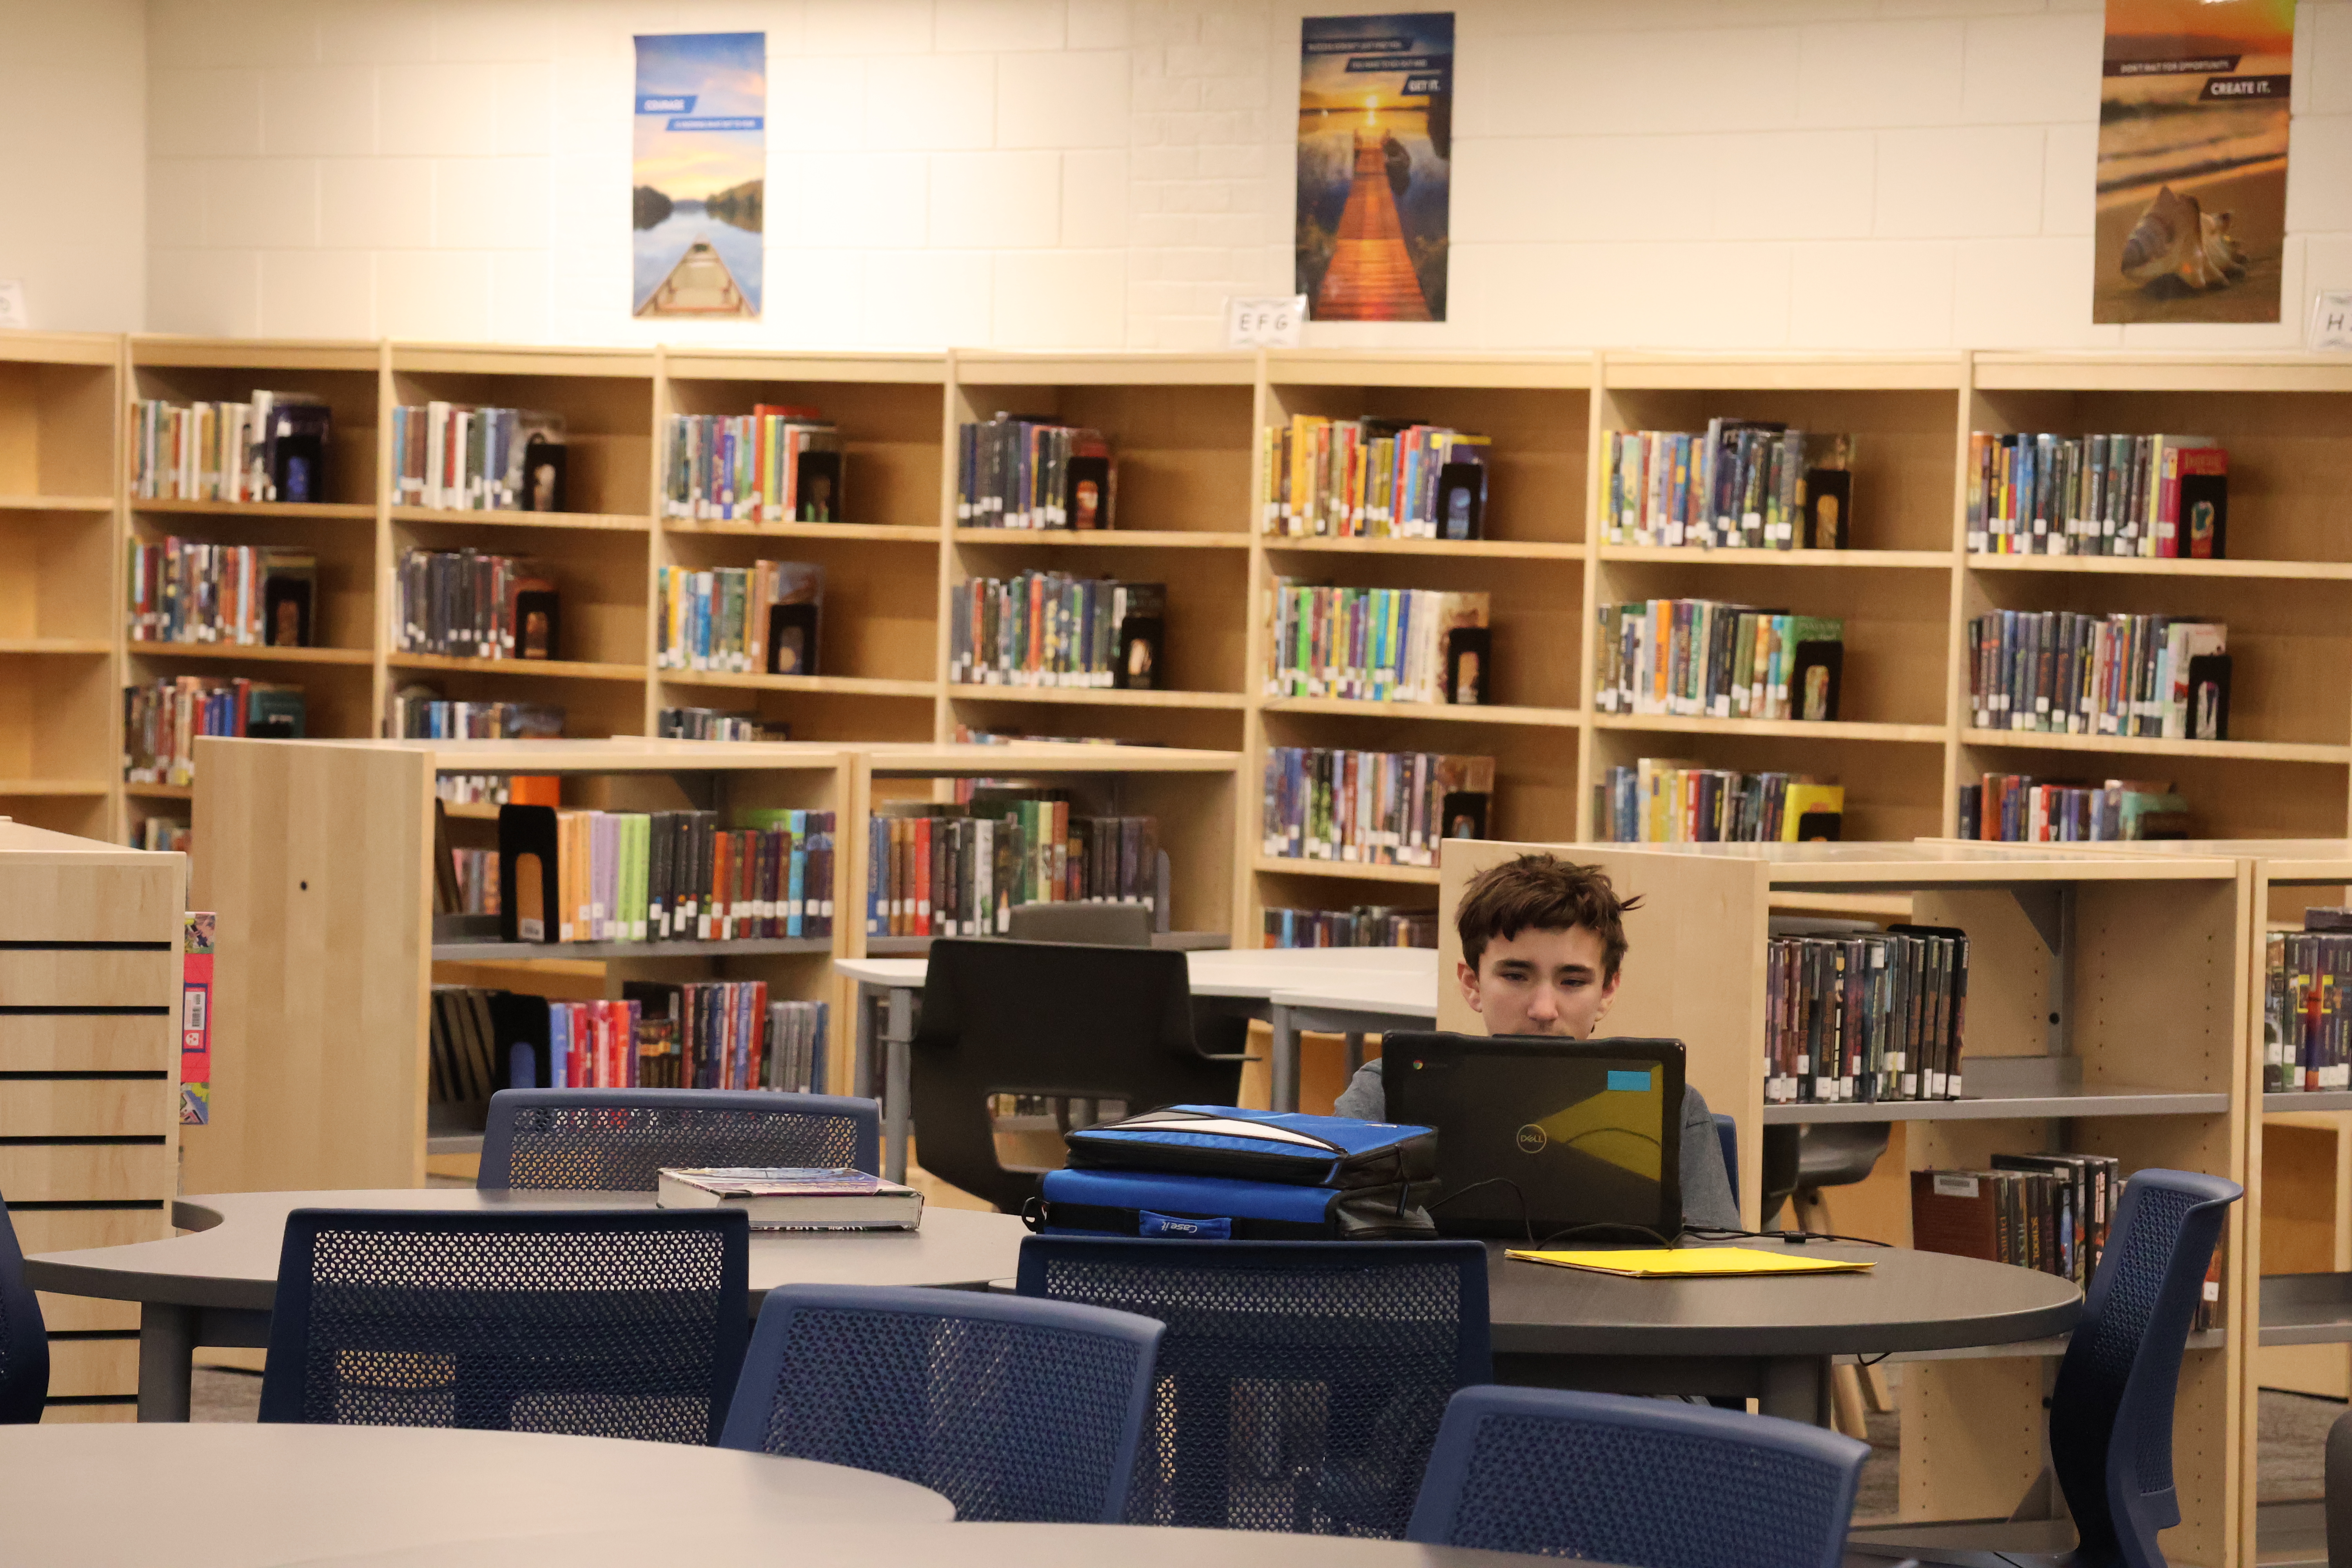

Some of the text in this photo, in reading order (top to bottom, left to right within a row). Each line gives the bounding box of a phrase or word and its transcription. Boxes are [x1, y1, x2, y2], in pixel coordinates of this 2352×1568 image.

[1408, 80, 1427, 92] GET
[2210, 81, 2254, 95] CREATE
[1239, 313, 1289, 331] E F G
[2327, 313, 2344, 331] H
[1521, 1134, 1544, 1143] DELL
[1170, 1223, 1198, 1233] Case
[2031, 1216, 2040, 1261] SCHOOL
